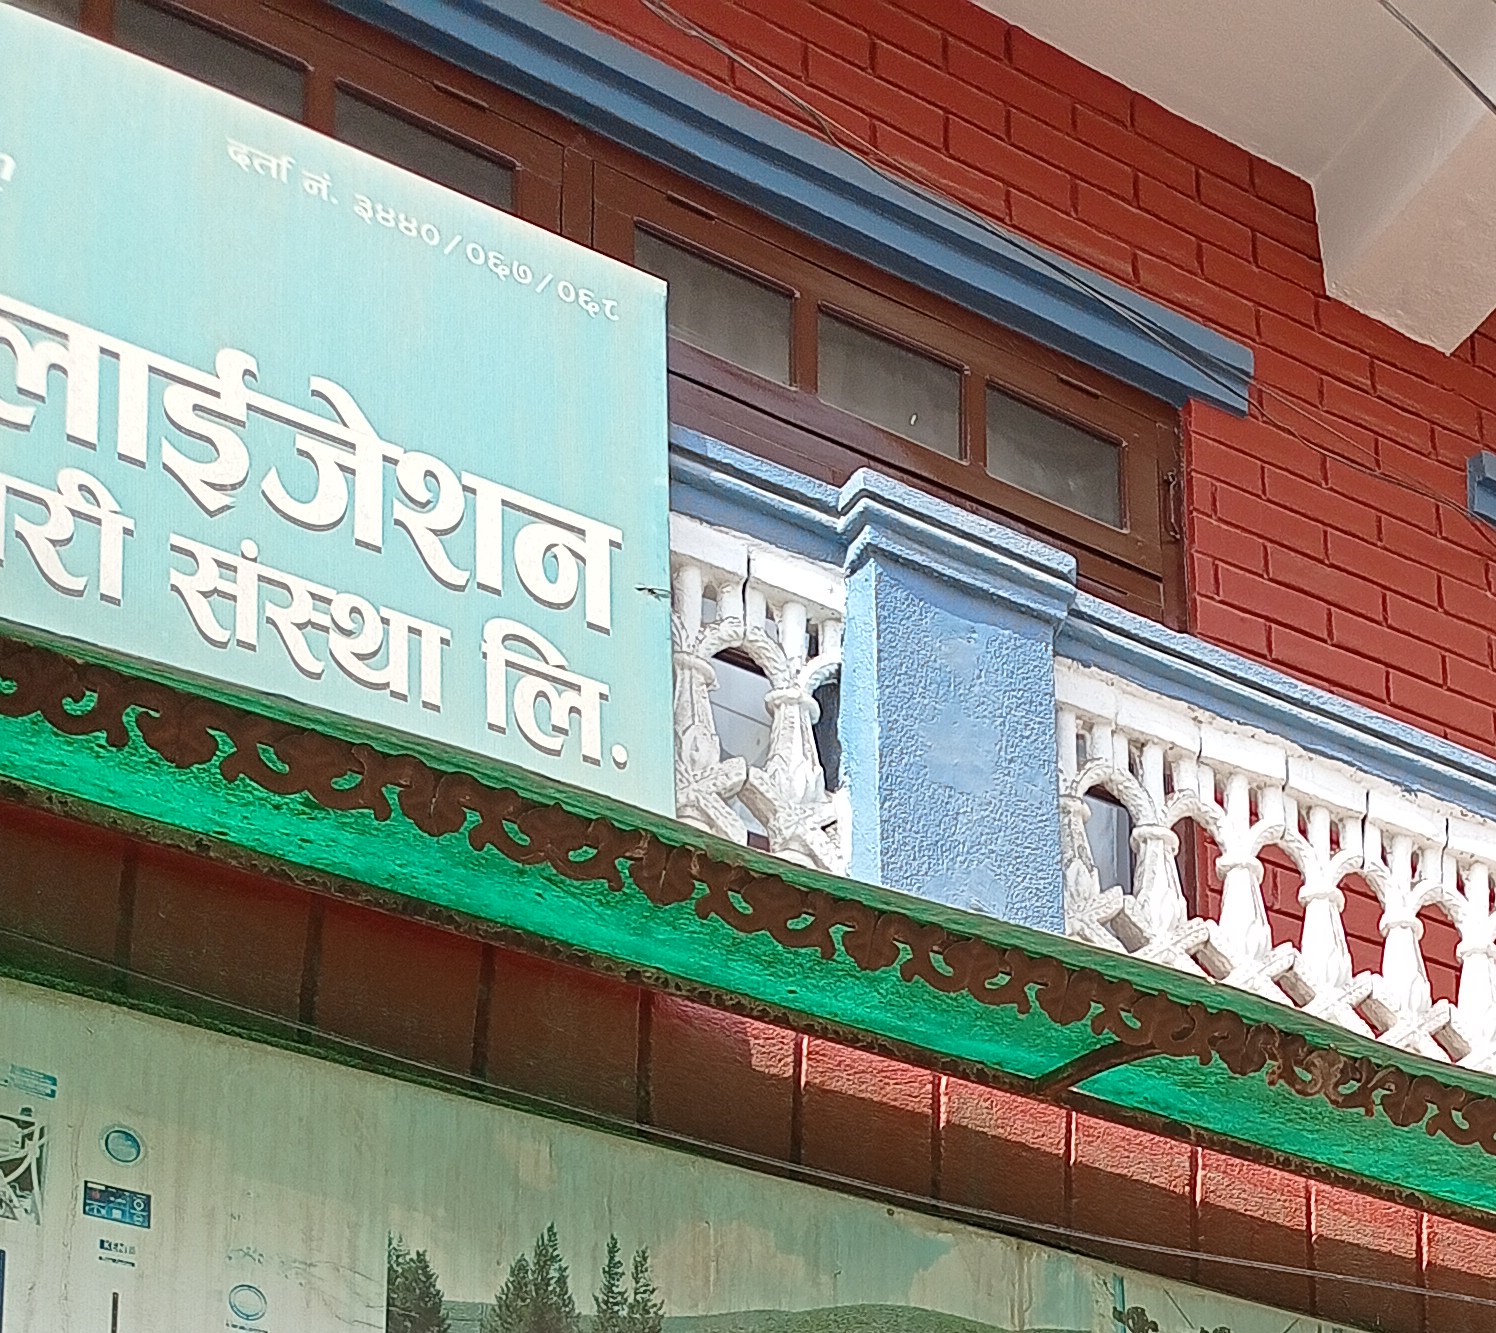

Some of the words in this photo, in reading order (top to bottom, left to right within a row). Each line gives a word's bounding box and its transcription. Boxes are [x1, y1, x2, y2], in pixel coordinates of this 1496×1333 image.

[226, 136, 296, 184] दर्ता
[167, 531, 450, 714] संस्था
[481, 617, 629, 771] लि.
